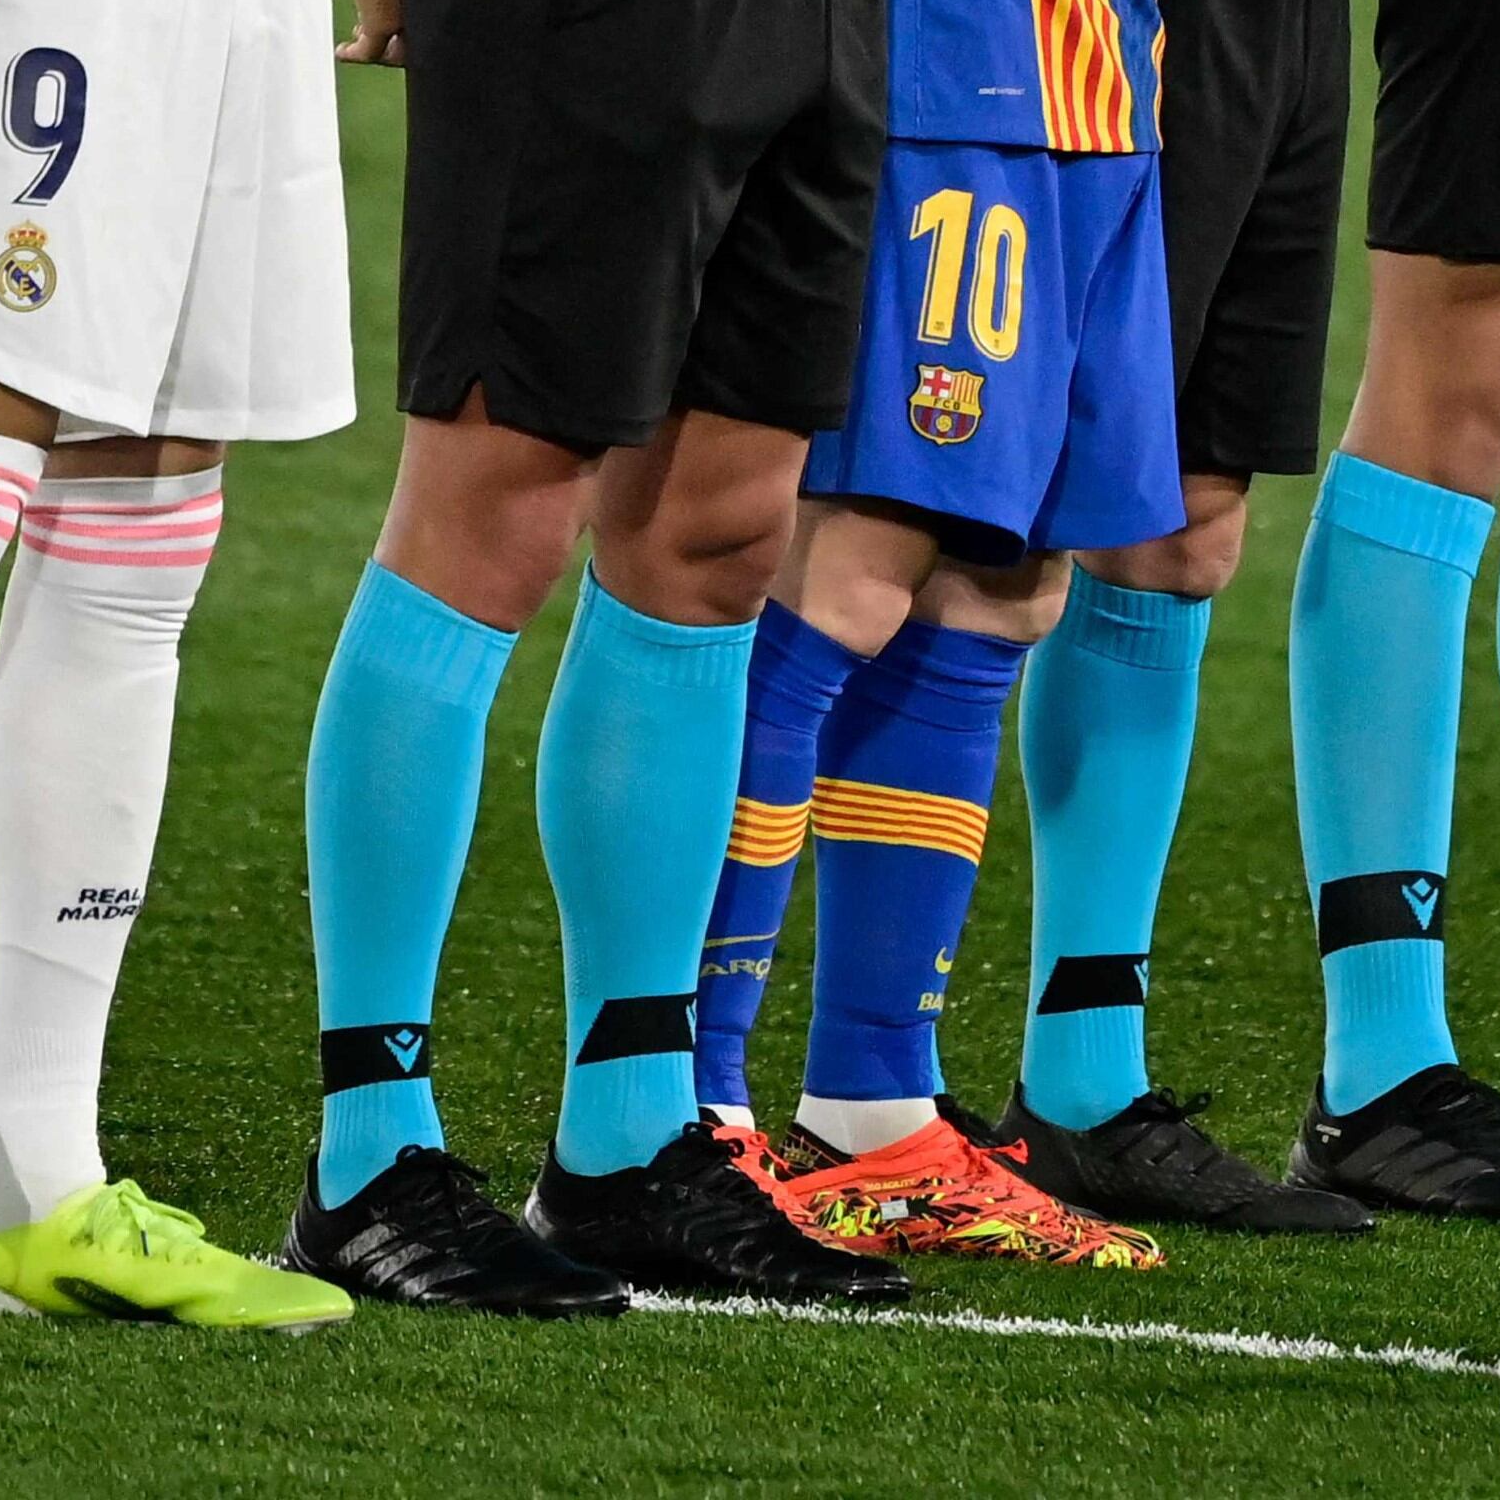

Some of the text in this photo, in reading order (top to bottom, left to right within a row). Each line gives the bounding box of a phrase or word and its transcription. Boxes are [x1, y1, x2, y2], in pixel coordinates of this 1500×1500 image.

[1, 46, 88, 206] 9
[909, 188, 1027, 362] 10
[57, 904, 143, 922] MADR
[78, 887, 141, 905] REAL
